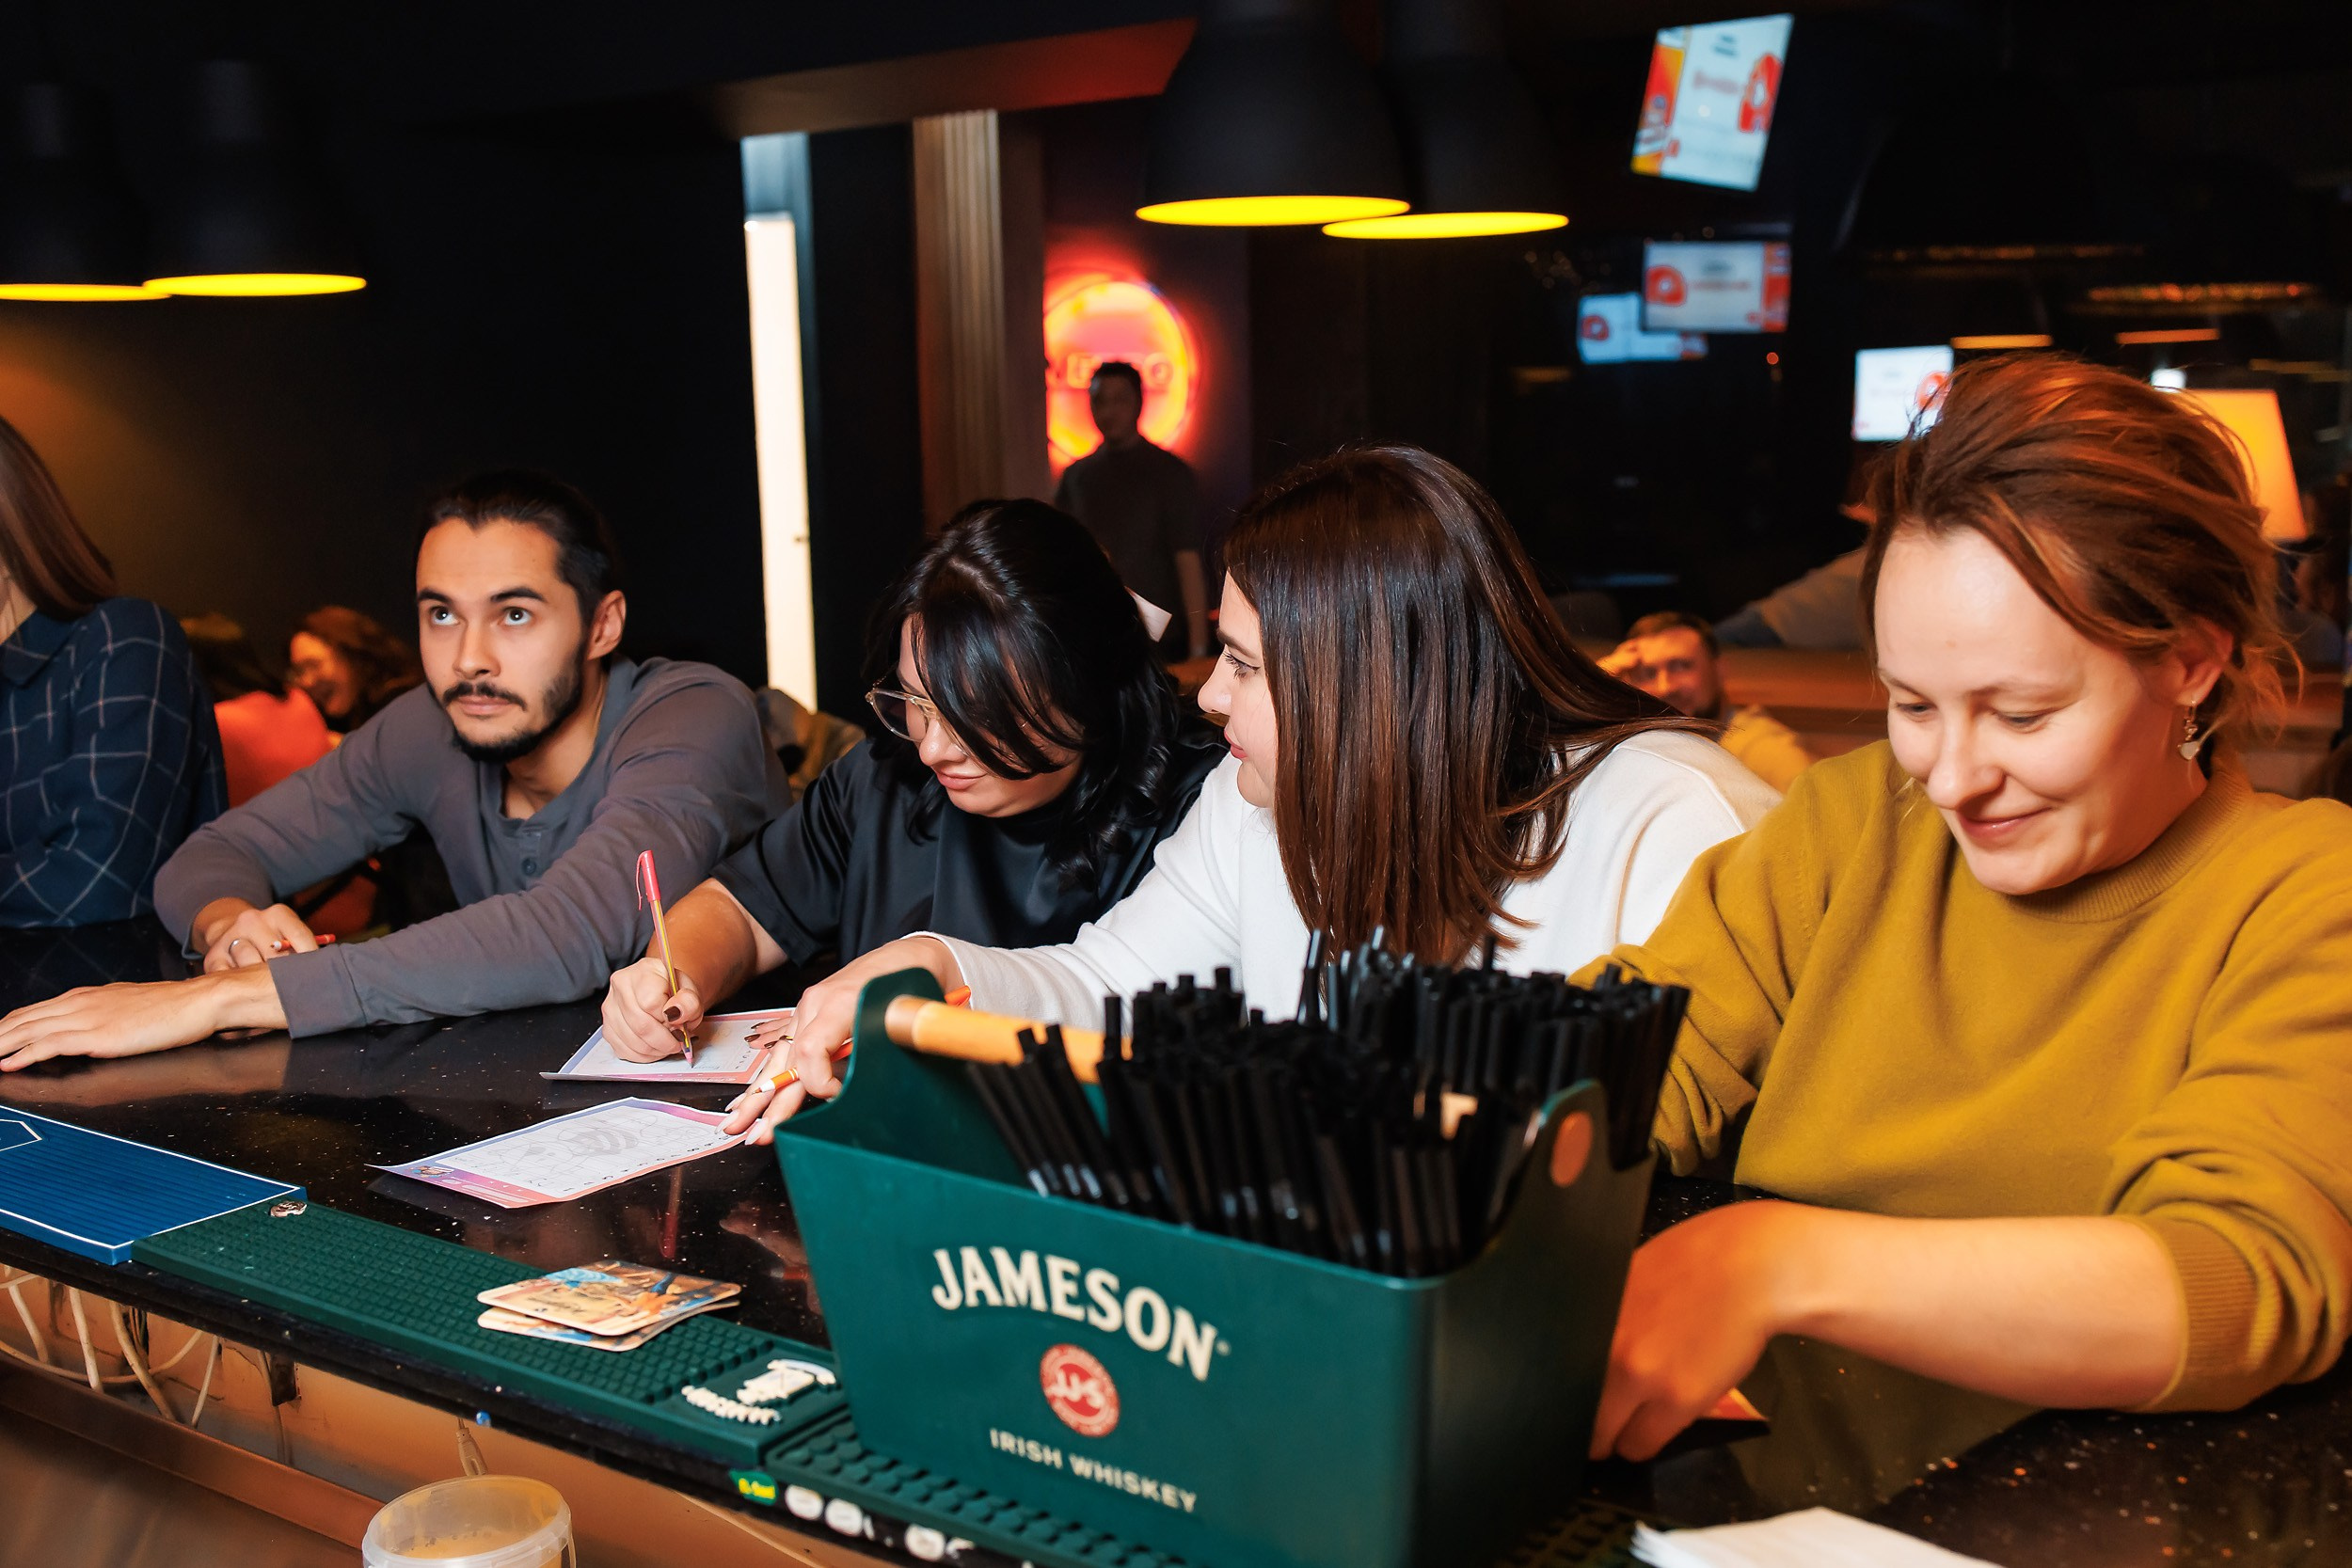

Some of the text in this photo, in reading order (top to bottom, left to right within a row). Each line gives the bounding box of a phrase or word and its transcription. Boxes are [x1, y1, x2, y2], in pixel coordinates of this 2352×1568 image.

[931, 1245, 1218, 1383] JAMESON
[990, 1428, 1197, 1513] IRISH WHISKEY
